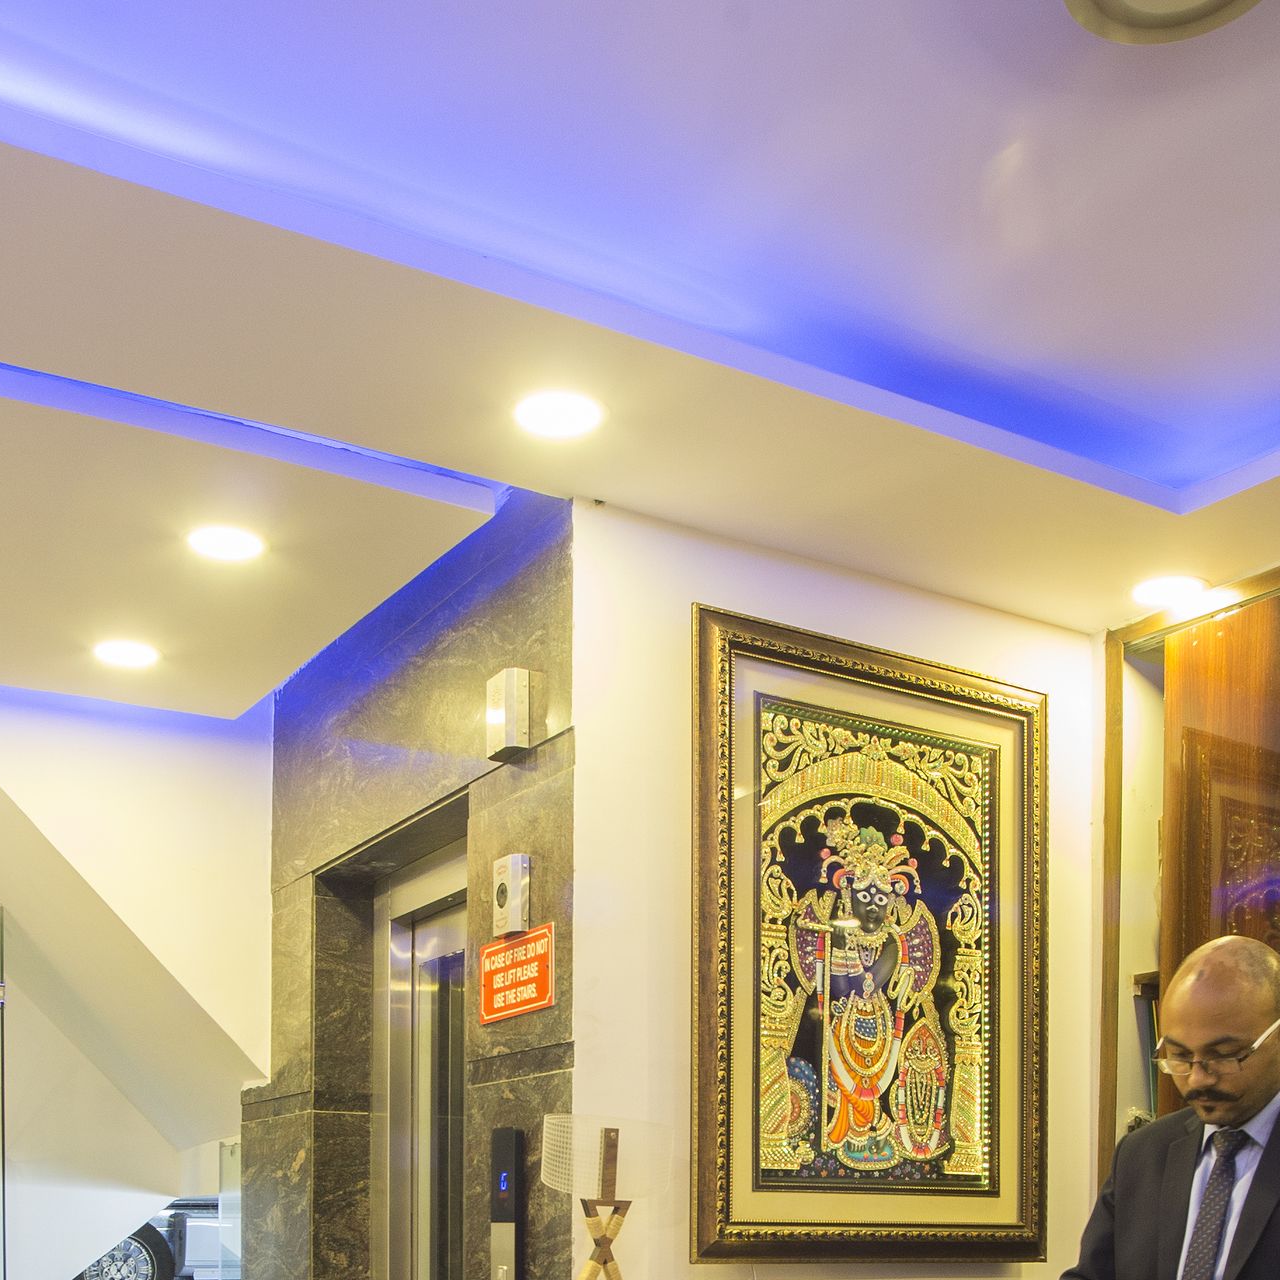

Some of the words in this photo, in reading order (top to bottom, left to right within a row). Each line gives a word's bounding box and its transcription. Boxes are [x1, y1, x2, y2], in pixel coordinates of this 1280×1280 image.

[484, 957, 491, 973] IN
[490, 952, 506, 971] CASE
[505, 949, 514, 966] OF
[513, 945, 527, 963] FIRE
[526, 942, 536, 959] DO
[535, 937, 549, 956] NOT
[493, 972, 505, 990] USE
[504, 968, 517, 986] LIFT
[516, 961, 539, 982] PLEASE
[493, 992, 505, 1009] USE
[505, 988, 517, 1006] THE
